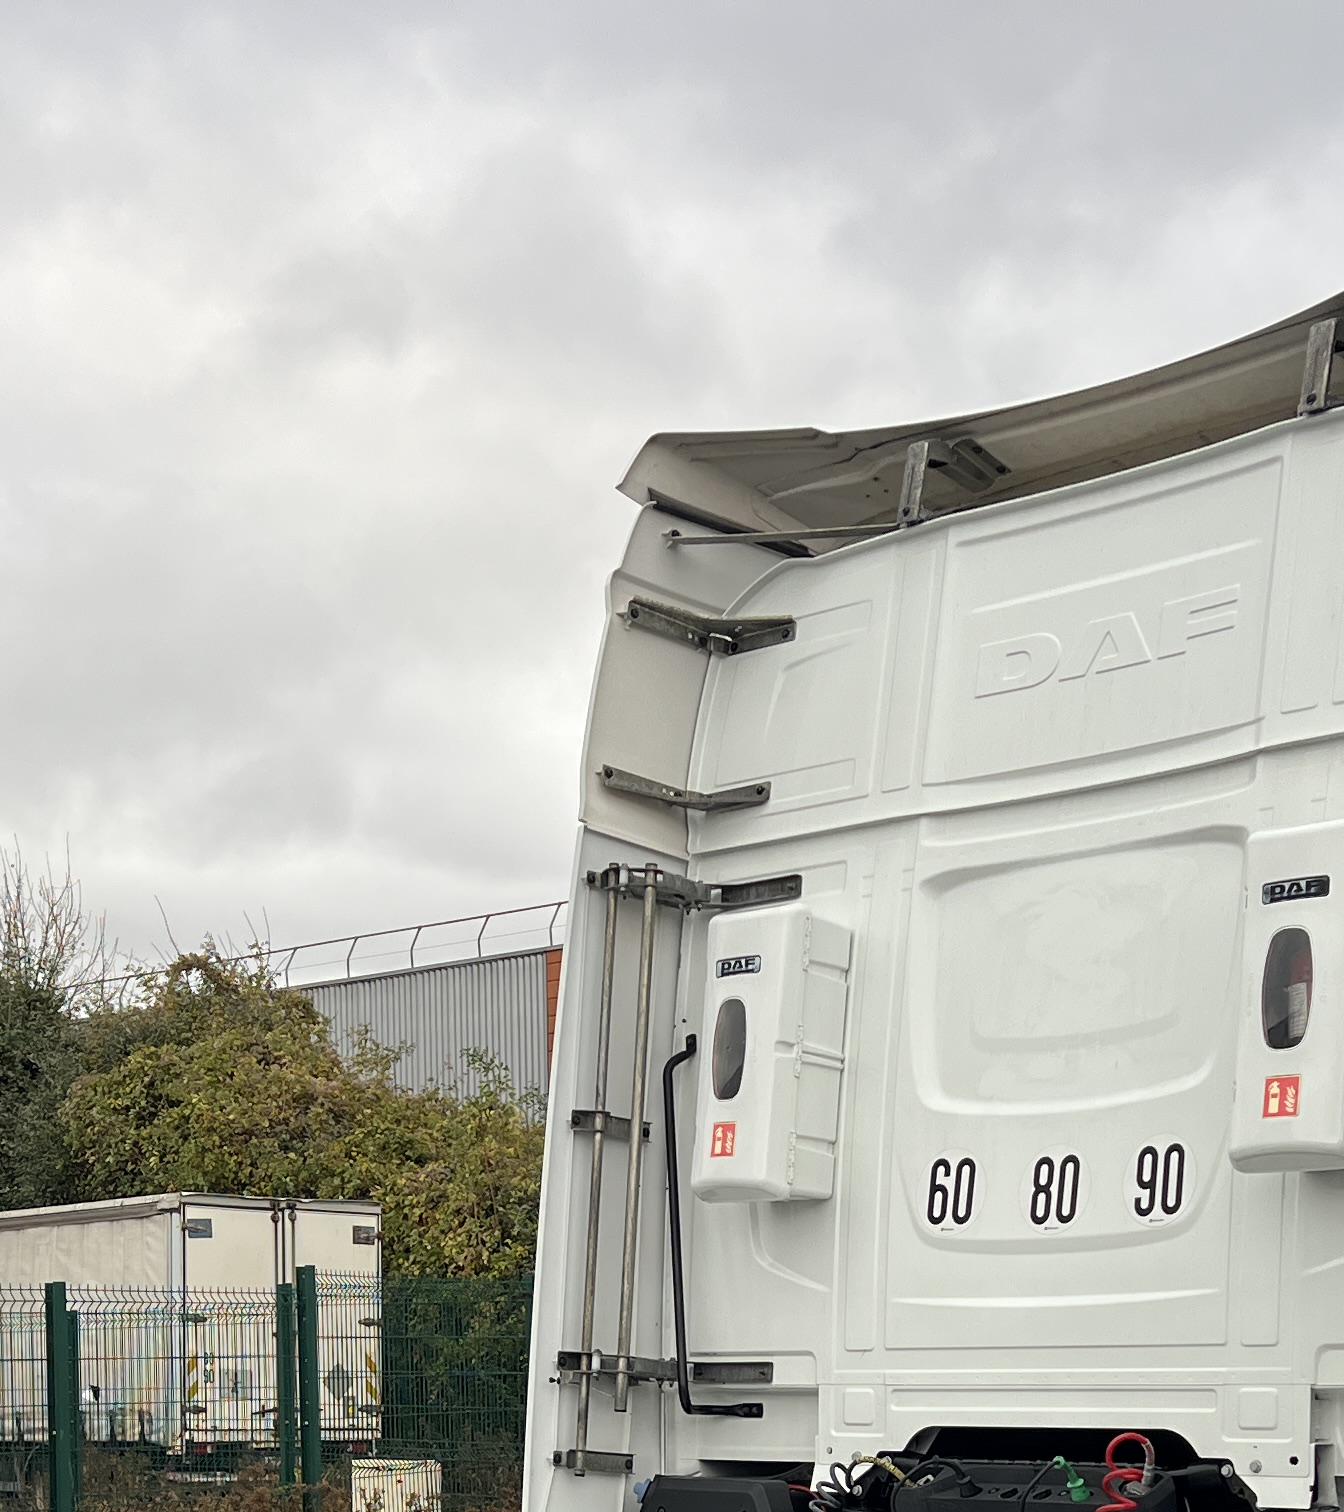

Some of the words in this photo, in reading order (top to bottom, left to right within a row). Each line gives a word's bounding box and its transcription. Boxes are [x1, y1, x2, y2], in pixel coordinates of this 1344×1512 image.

[974, 583, 1241, 698] DAF
[1268, 878, 1324, 900] DAF
[721, 957, 756, 974] DAF
[927, 1157, 976, 1225] 60
[1030, 1154, 1080, 1225] 80
[1134, 1143, 1185, 1217] 90
